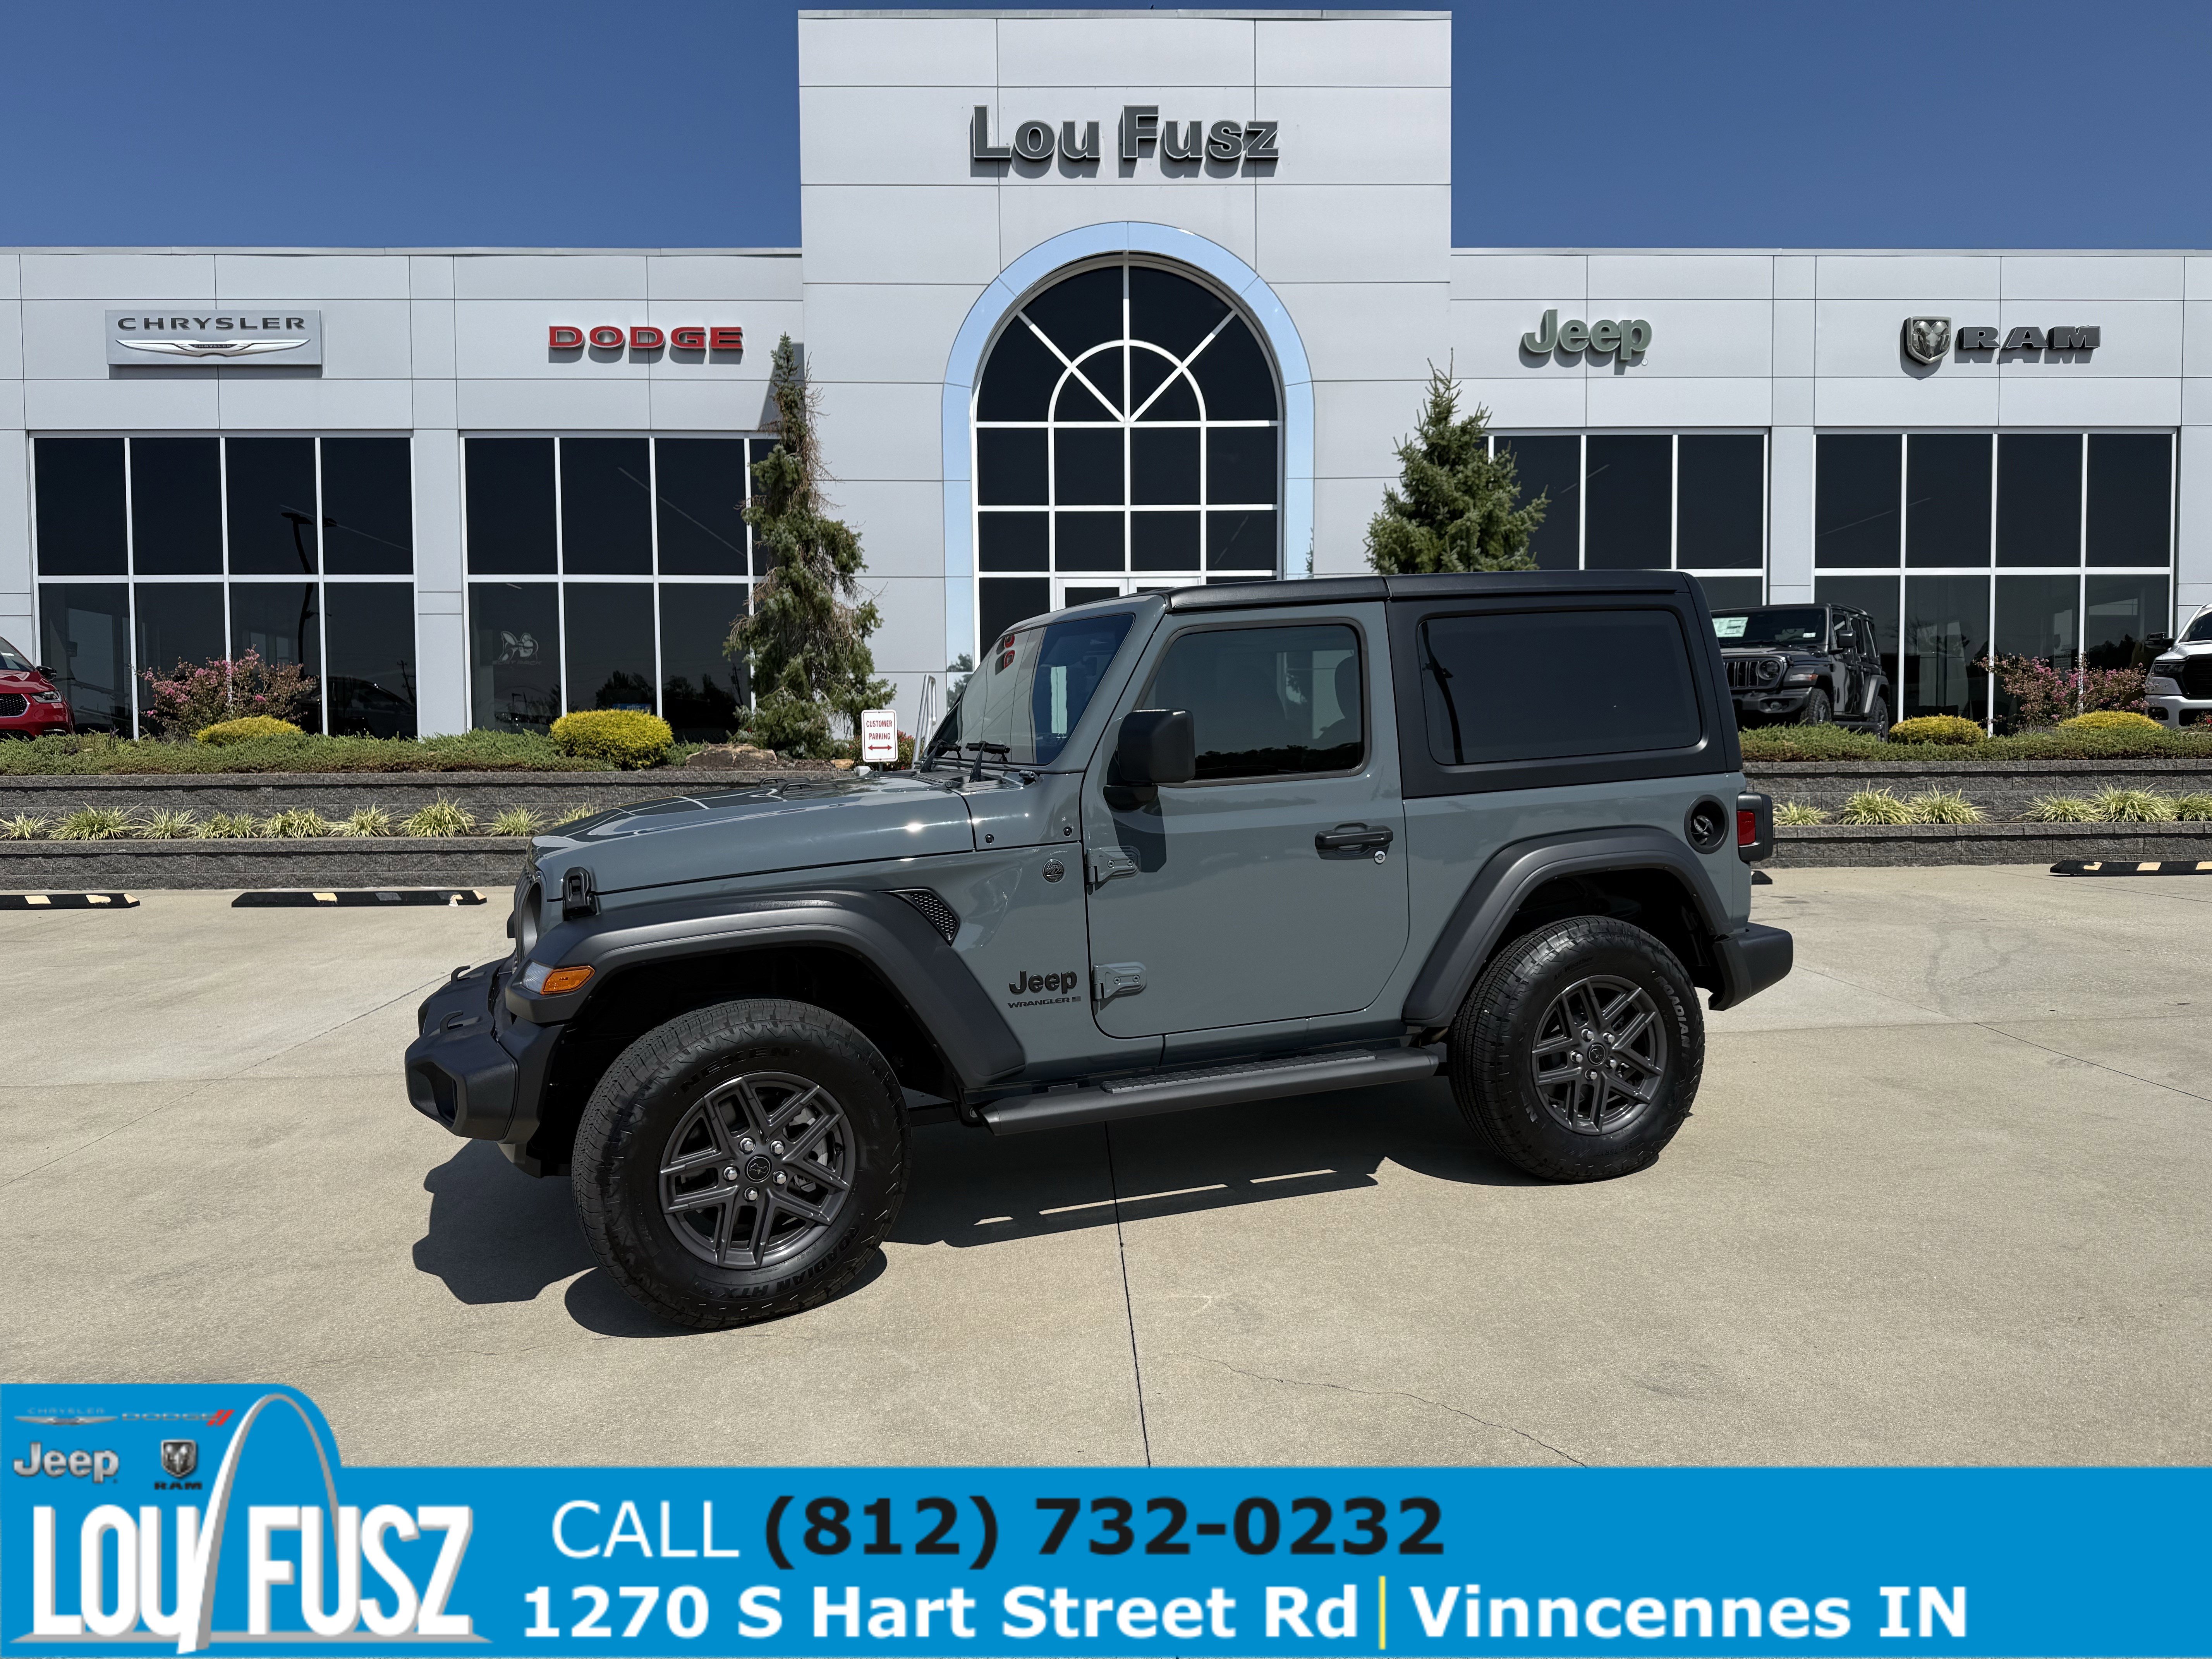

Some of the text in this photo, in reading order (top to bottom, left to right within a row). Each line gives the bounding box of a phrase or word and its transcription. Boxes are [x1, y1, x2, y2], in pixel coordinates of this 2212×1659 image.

[972, 105, 1279, 160] Lou Fusz
[117, 317, 305, 330] CHRYSLER
[549, 326, 743, 350] DODGE
[1522, 309, 1652, 361] Jeep
[1960, 326, 2101, 349] RAM
[1009, 970, 1077, 995] Jeep
[1007, 997, 1070, 1008] WRANGLER
[1654, 975, 1690, 1048] ROADIAN
[680, 1047, 792, 1093] NEXEN
[776, 1227, 861, 1293] ROADIAN
